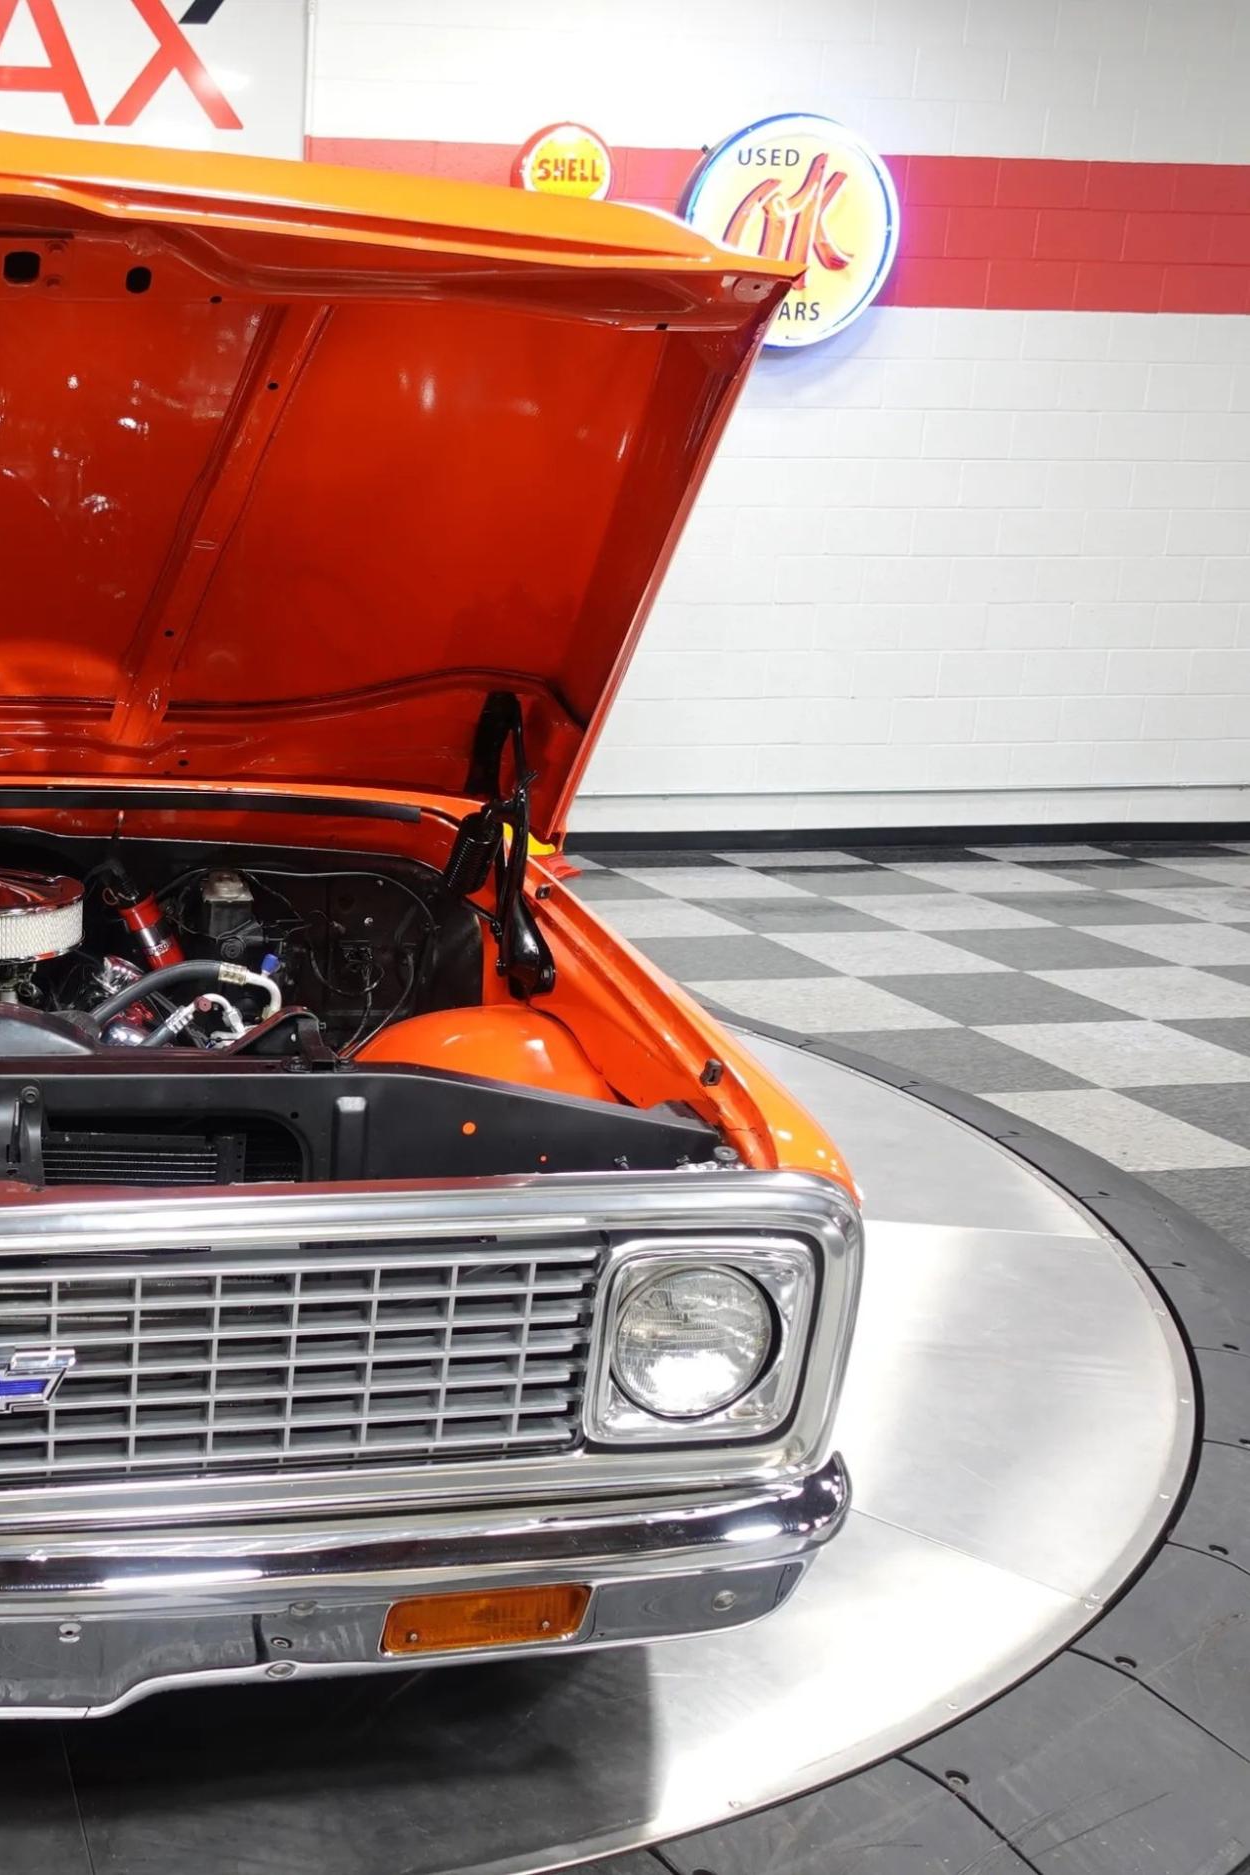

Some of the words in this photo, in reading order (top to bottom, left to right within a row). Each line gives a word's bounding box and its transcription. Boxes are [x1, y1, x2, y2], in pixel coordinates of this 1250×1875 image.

[738, 148, 800, 166] USED
[537, 158, 601, 182] SHELL
[777, 302, 820, 320] ARS
